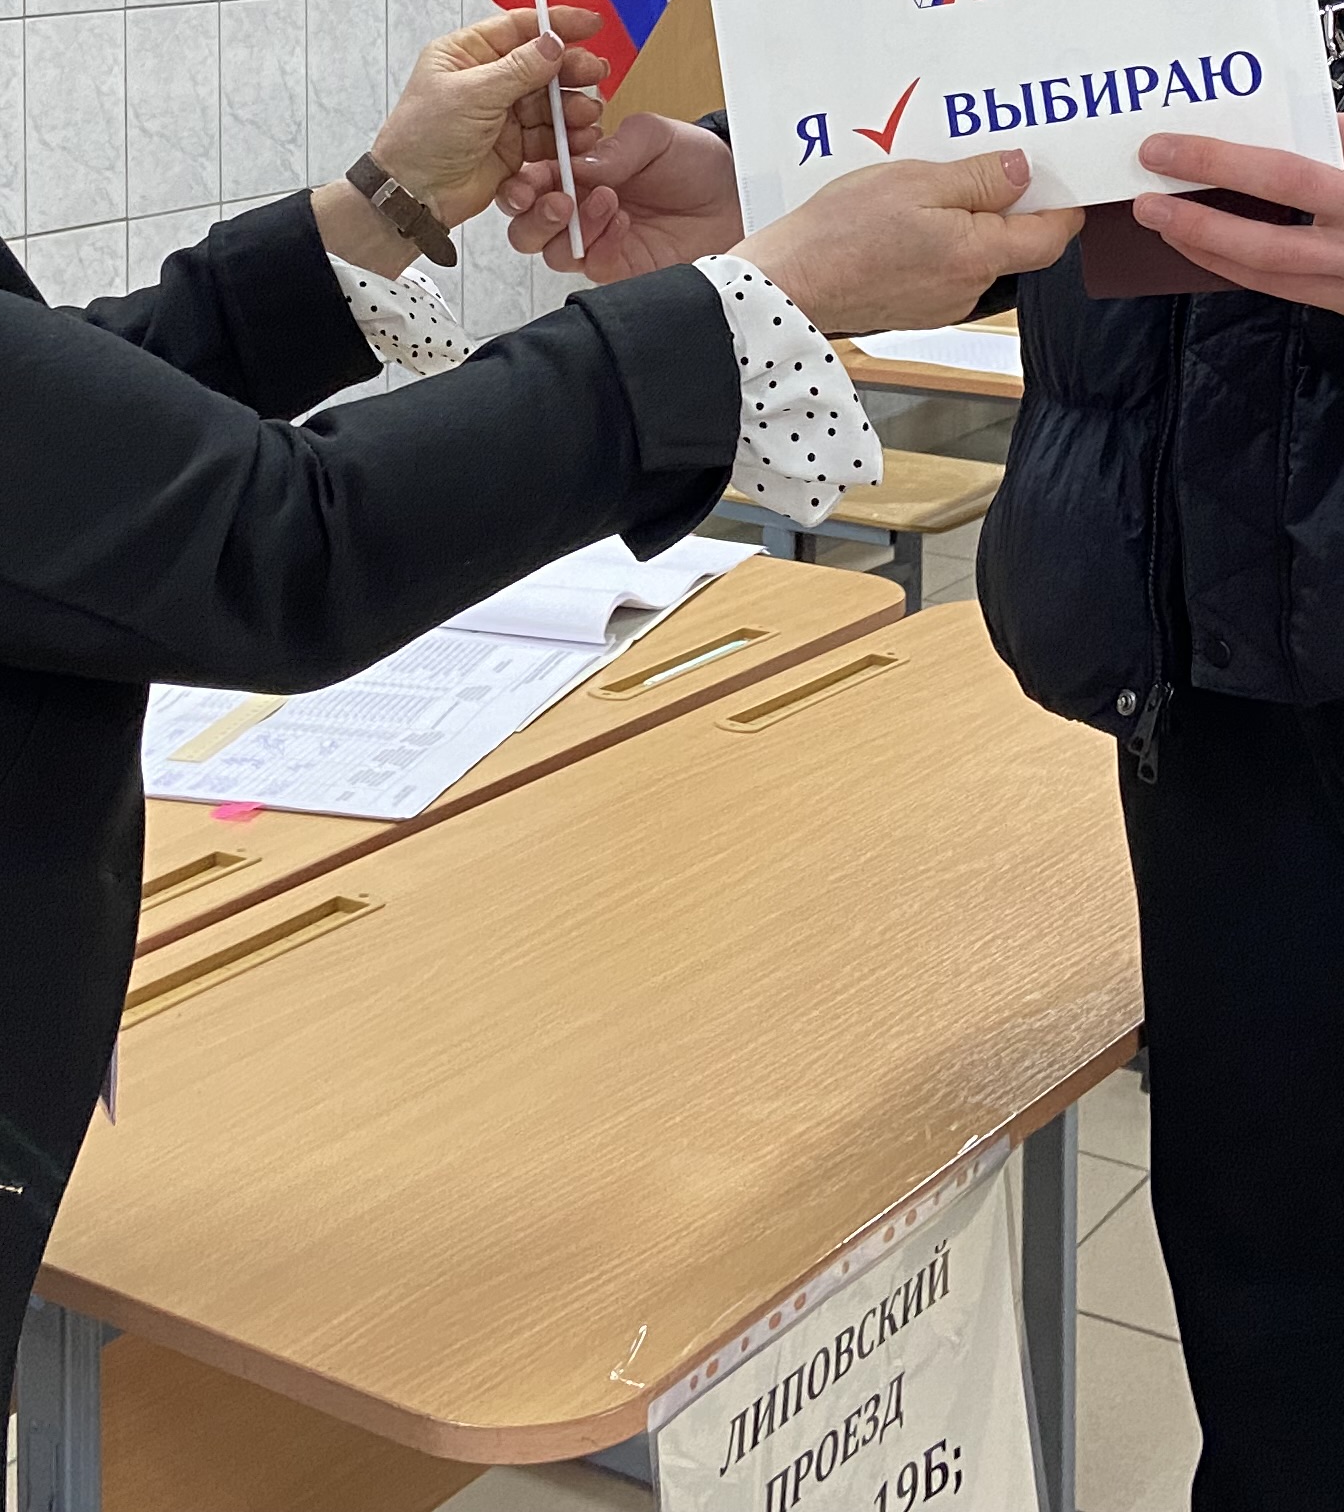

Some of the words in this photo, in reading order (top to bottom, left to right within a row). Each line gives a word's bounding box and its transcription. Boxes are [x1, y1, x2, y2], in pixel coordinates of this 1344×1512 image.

[795, 112, 834, 167] Я
[942, 50, 1264, 139] ВЫБИРАЮ
[719, 1238, 952, 1477] ЛИПОВСКИЙ
[764, 1370, 906, 1512] ПРОЕЗД
[873, 1438, 963, 1512] 19Б;
